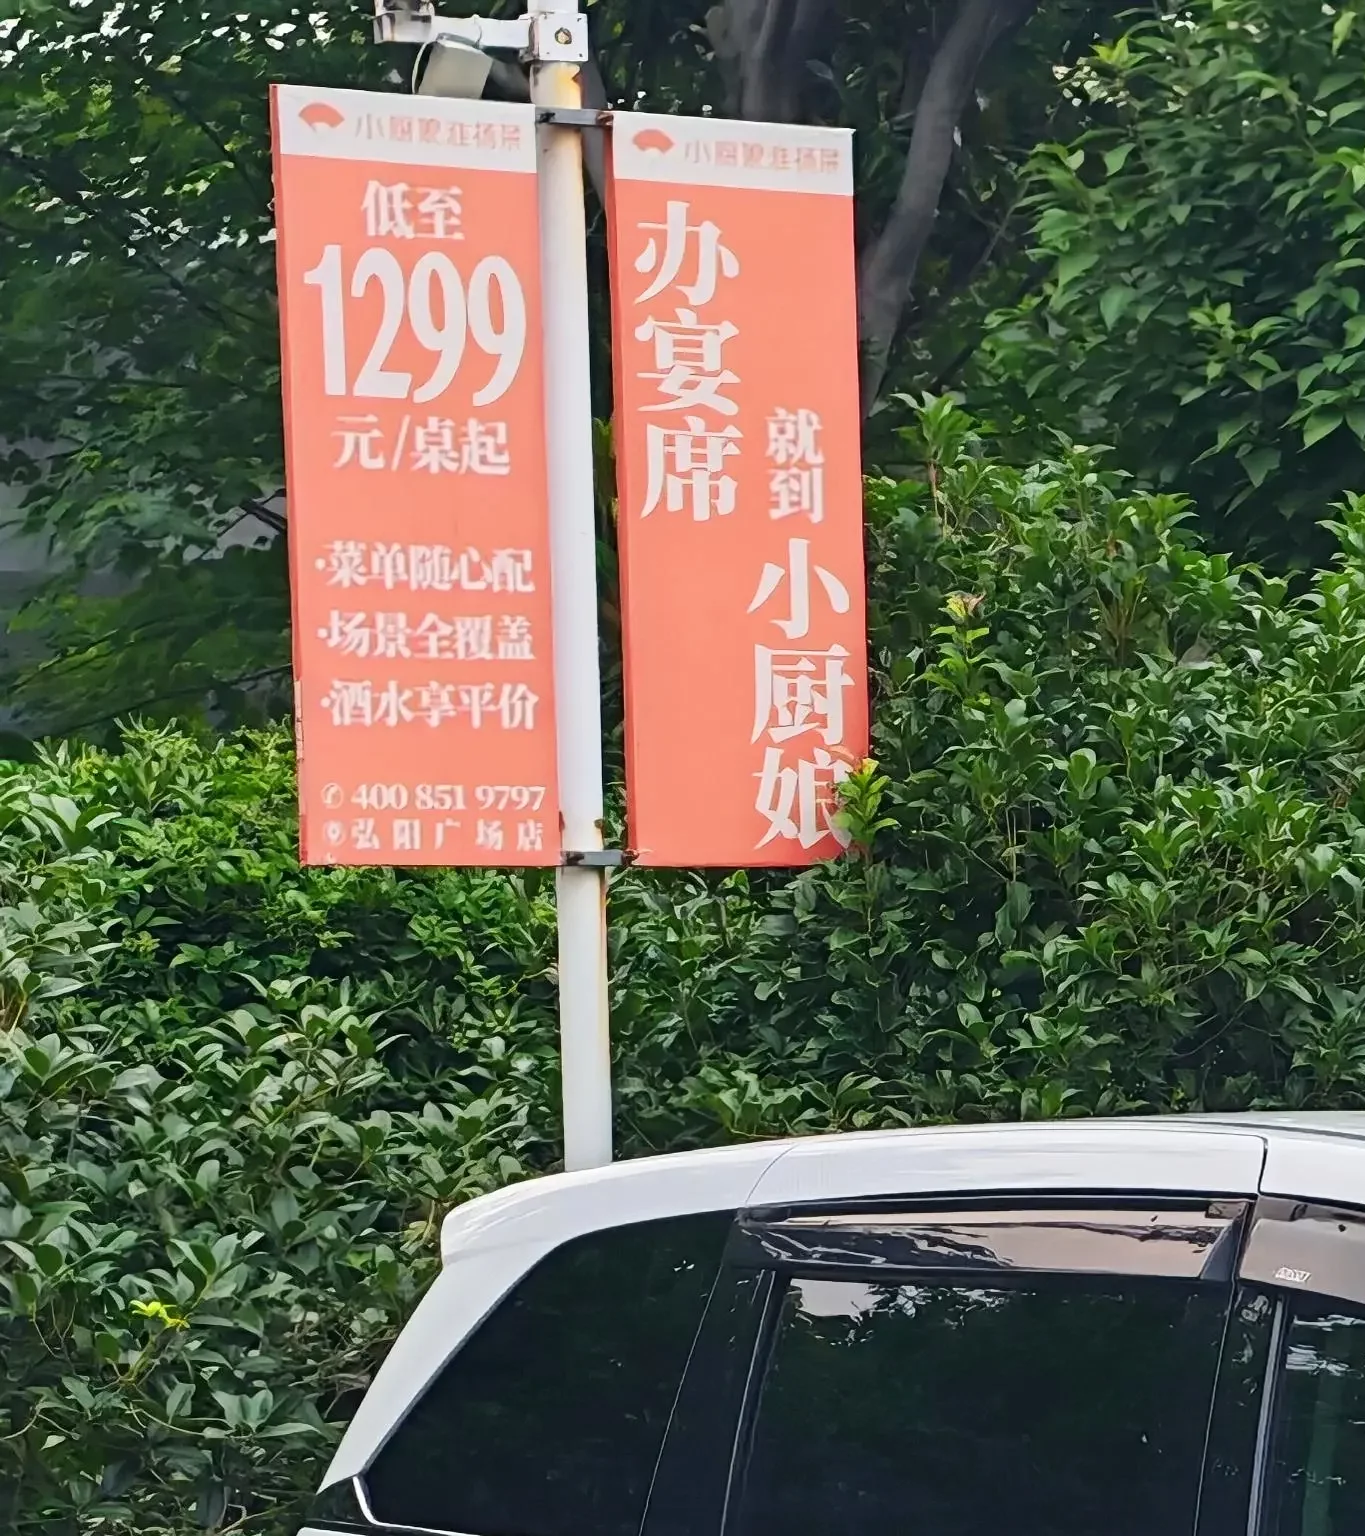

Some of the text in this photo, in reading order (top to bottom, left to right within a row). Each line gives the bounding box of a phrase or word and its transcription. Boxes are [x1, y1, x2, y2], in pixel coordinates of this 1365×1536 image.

[360, 179, 465, 241] 低至
[303, 245, 526, 407] 1299
[633, 201, 743, 522] 办宴席
[331, 414, 511, 476] 元/桌起
[747, 406, 855, 849] 就到 小厨娘
[351, 783, 546, 812] 400 851 9797
[352, 817, 544, 851] 弘阳广场店
